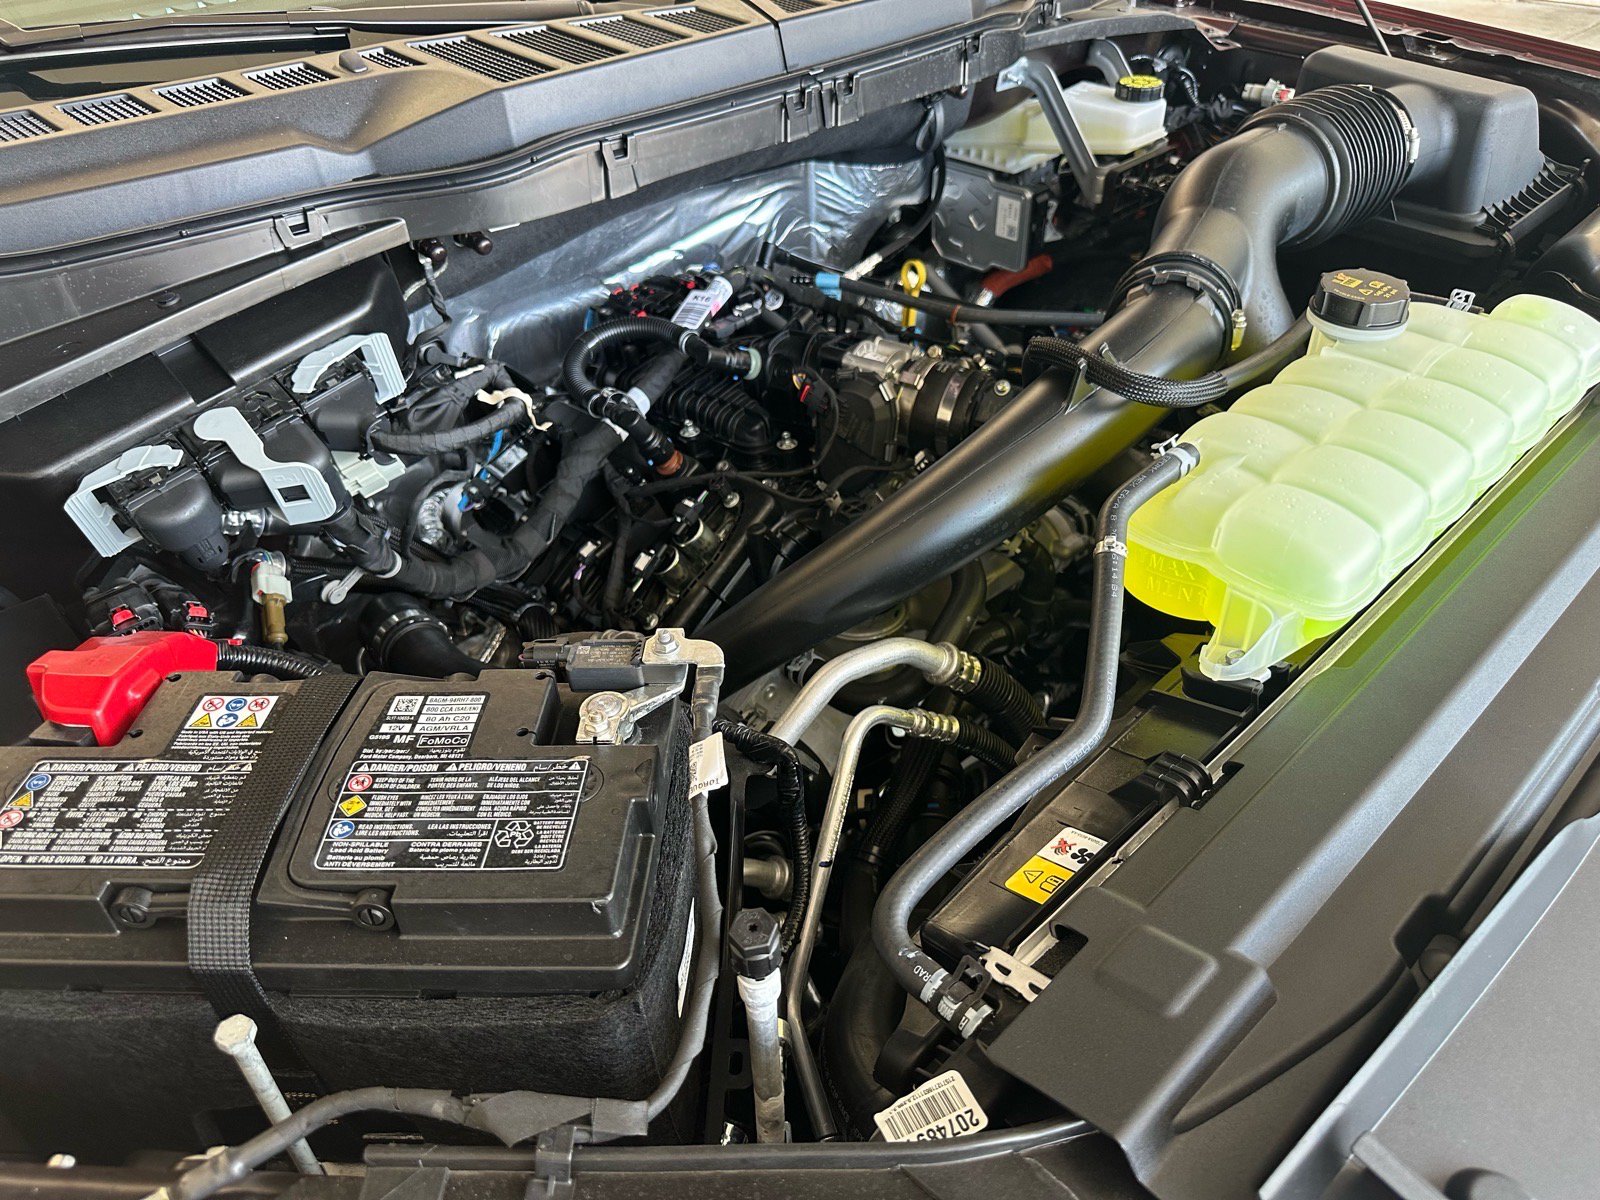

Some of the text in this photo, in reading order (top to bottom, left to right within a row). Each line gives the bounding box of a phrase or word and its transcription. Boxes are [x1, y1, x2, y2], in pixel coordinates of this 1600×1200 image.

[1148, 554, 1195, 580] MAX
[1146, 577, 1192, 602] MIN
[392, 735, 416, 744] MF
[418, 736, 468, 745] FoMoCo
[50, 763, 119, 772] DANGER/POISON
[134, 763, 203, 772] PELIGRO/VENENO
[369, 764, 440, 772] DANGER/POISON
[457, 763, 527, 771] PELIGRO/VENENO
[690, 778, 720, 794] TORQUE
[26, 856, 39, 864] NE
[40, 856, 55, 864] PAS
[54, 856, 86, 864] OUVRIR.
[90, 856, 138, 864] NO LA ABRA.
[913, 965, 931, 982] RAD
